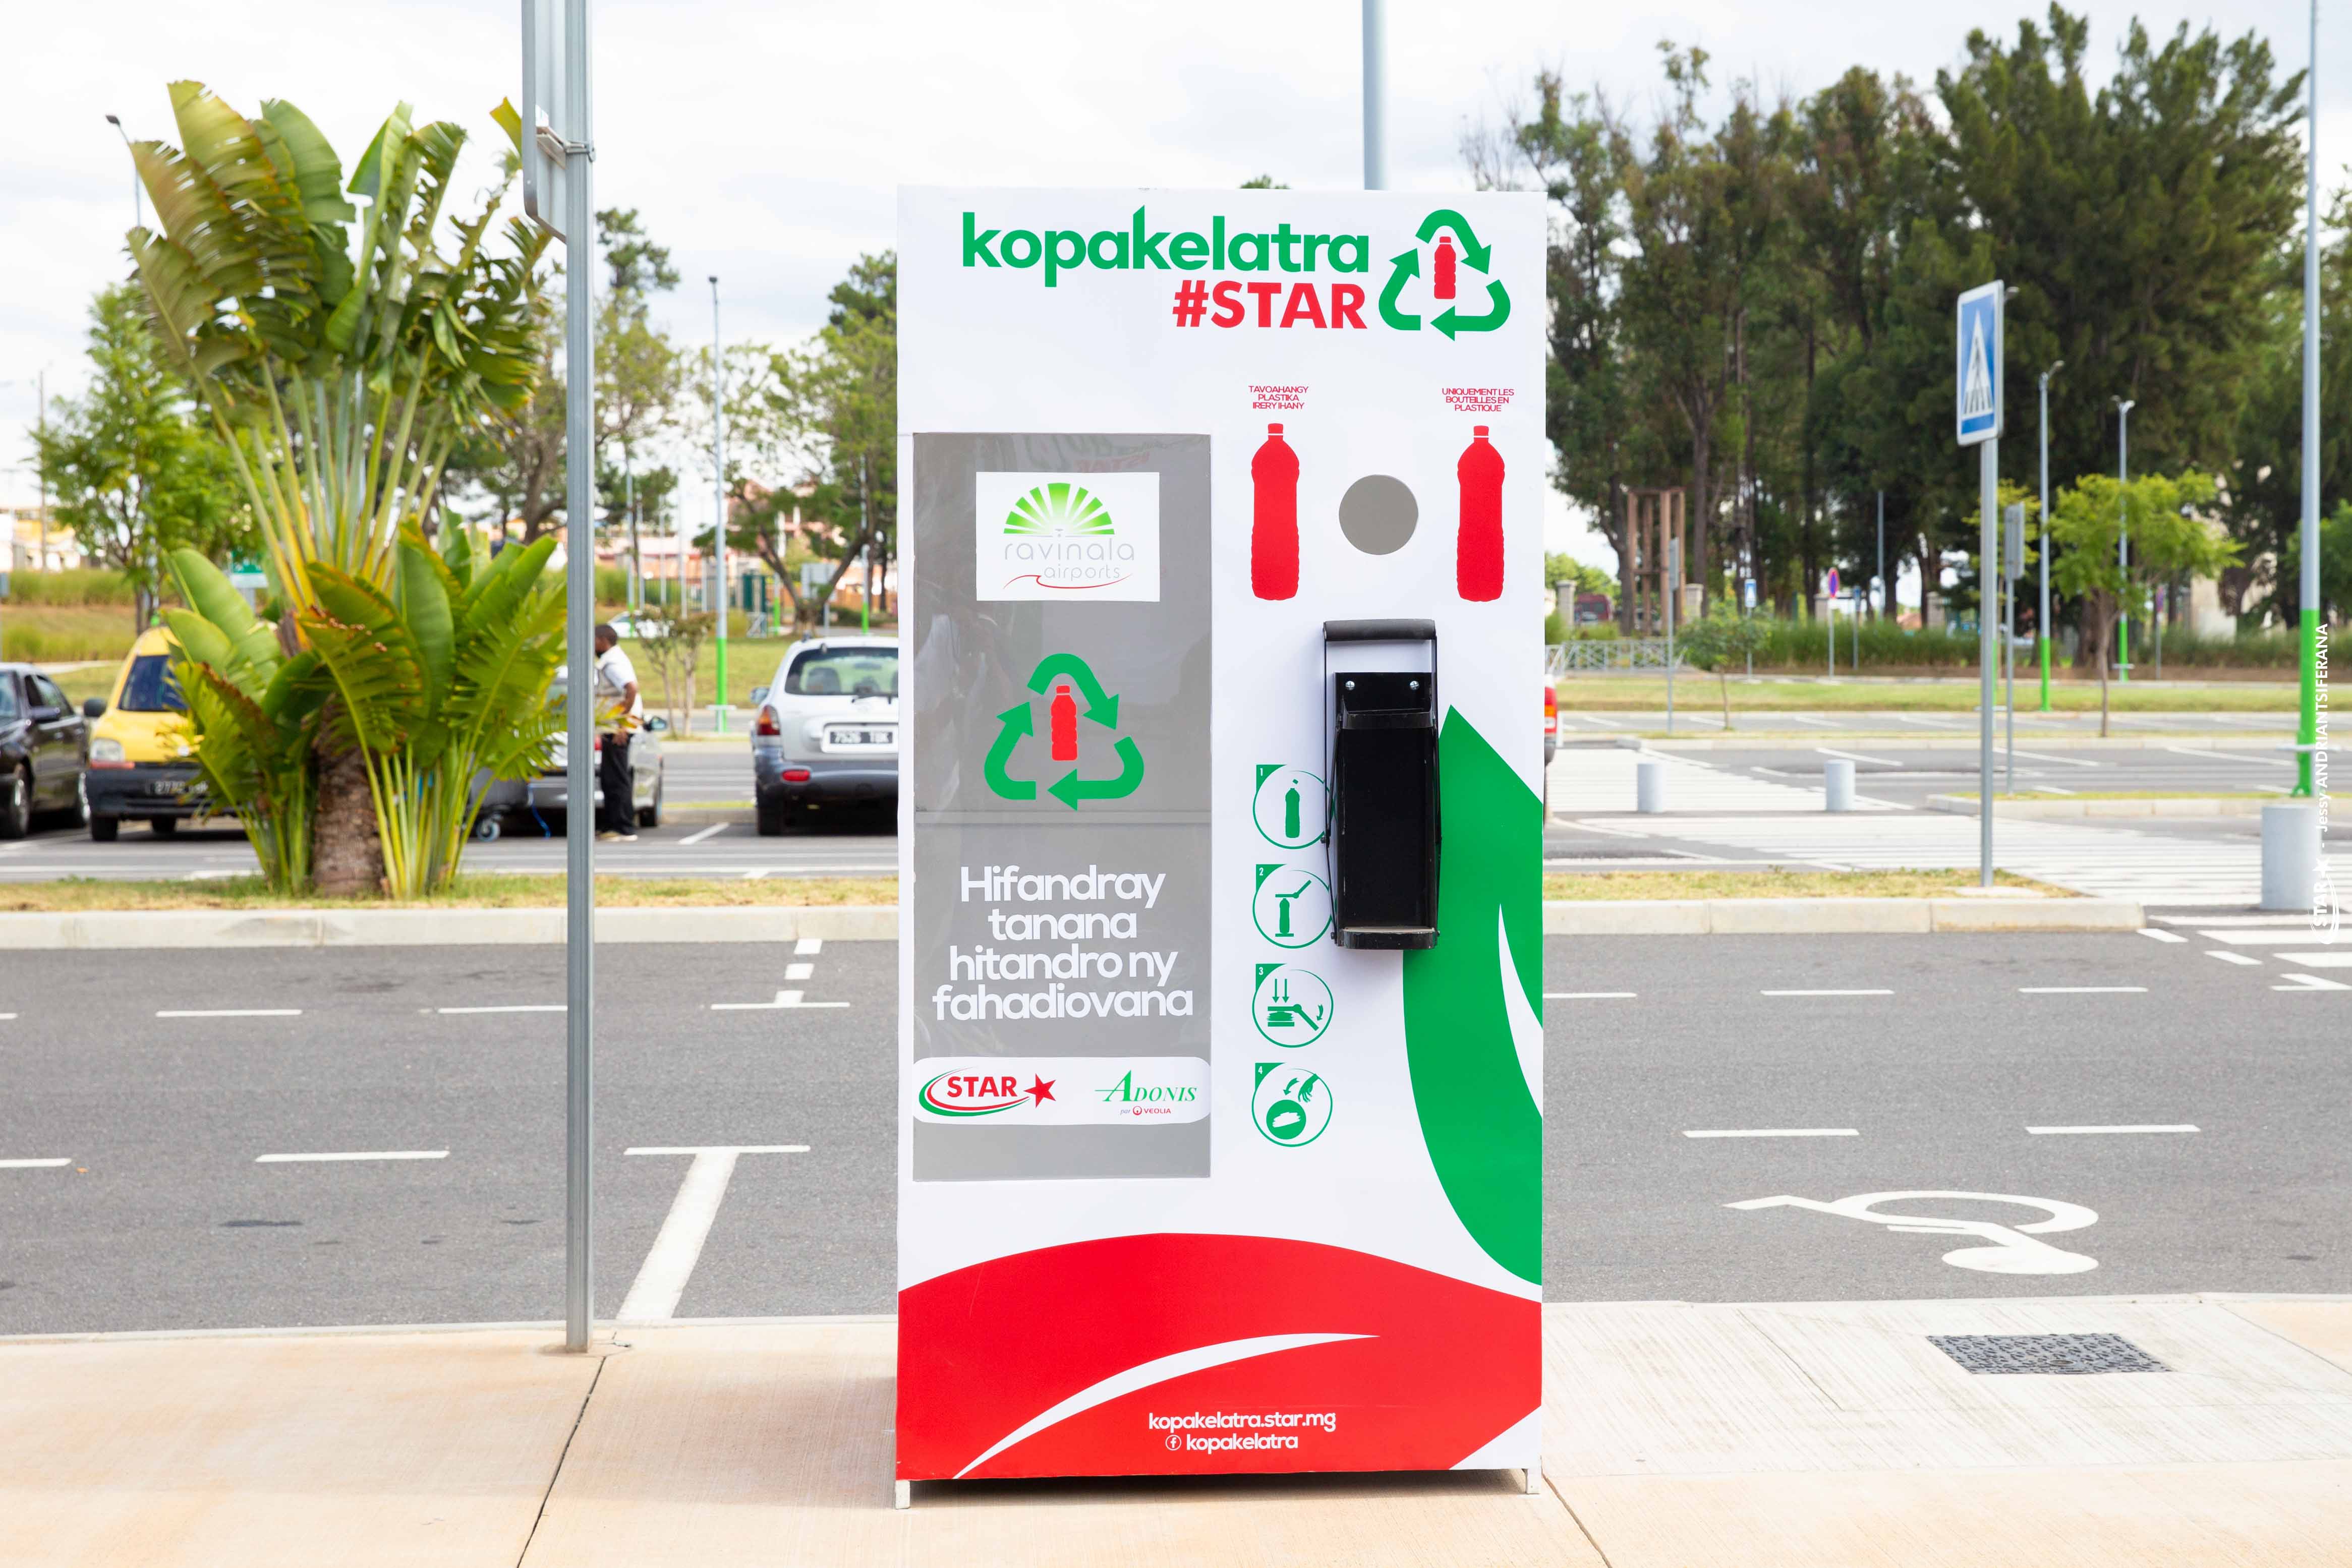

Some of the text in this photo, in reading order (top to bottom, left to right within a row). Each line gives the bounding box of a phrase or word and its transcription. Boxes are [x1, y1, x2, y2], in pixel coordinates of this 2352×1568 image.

[962, 205, 1369, 287] kopakelatra
[1172, 279, 1367, 329] #STAR
[1248, 385, 1308, 393] TAVOAHANGY
[1442, 388, 1498, 396] UNIQUEMENT
[1454, 404, 1502, 412] PLASTIQUE
[1004, 537, 1134, 561] ravinala
[1044, 563, 1120, 582] airports
[1259, 768, 1264, 776] 1
[1258, 867, 1264, 876] 2
[960, 864, 1166, 908] Hifandray
[988, 908, 1137, 941] tanana
[950, 943, 1179, 987] hitandro ny
[1258, 966, 1264, 975] 3
[932, 982, 1194, 1021] fahadiovana
[1258, 1065, 1263, 1074] 4
[947, 1076, 1017, 1098] STAR
[1120, 1109, 1131, 1117] par
[1149, 1412, 1336, 1433] kopakelatra.star.mg
[1186, 1433, 1298, 1454] kopakelatra
